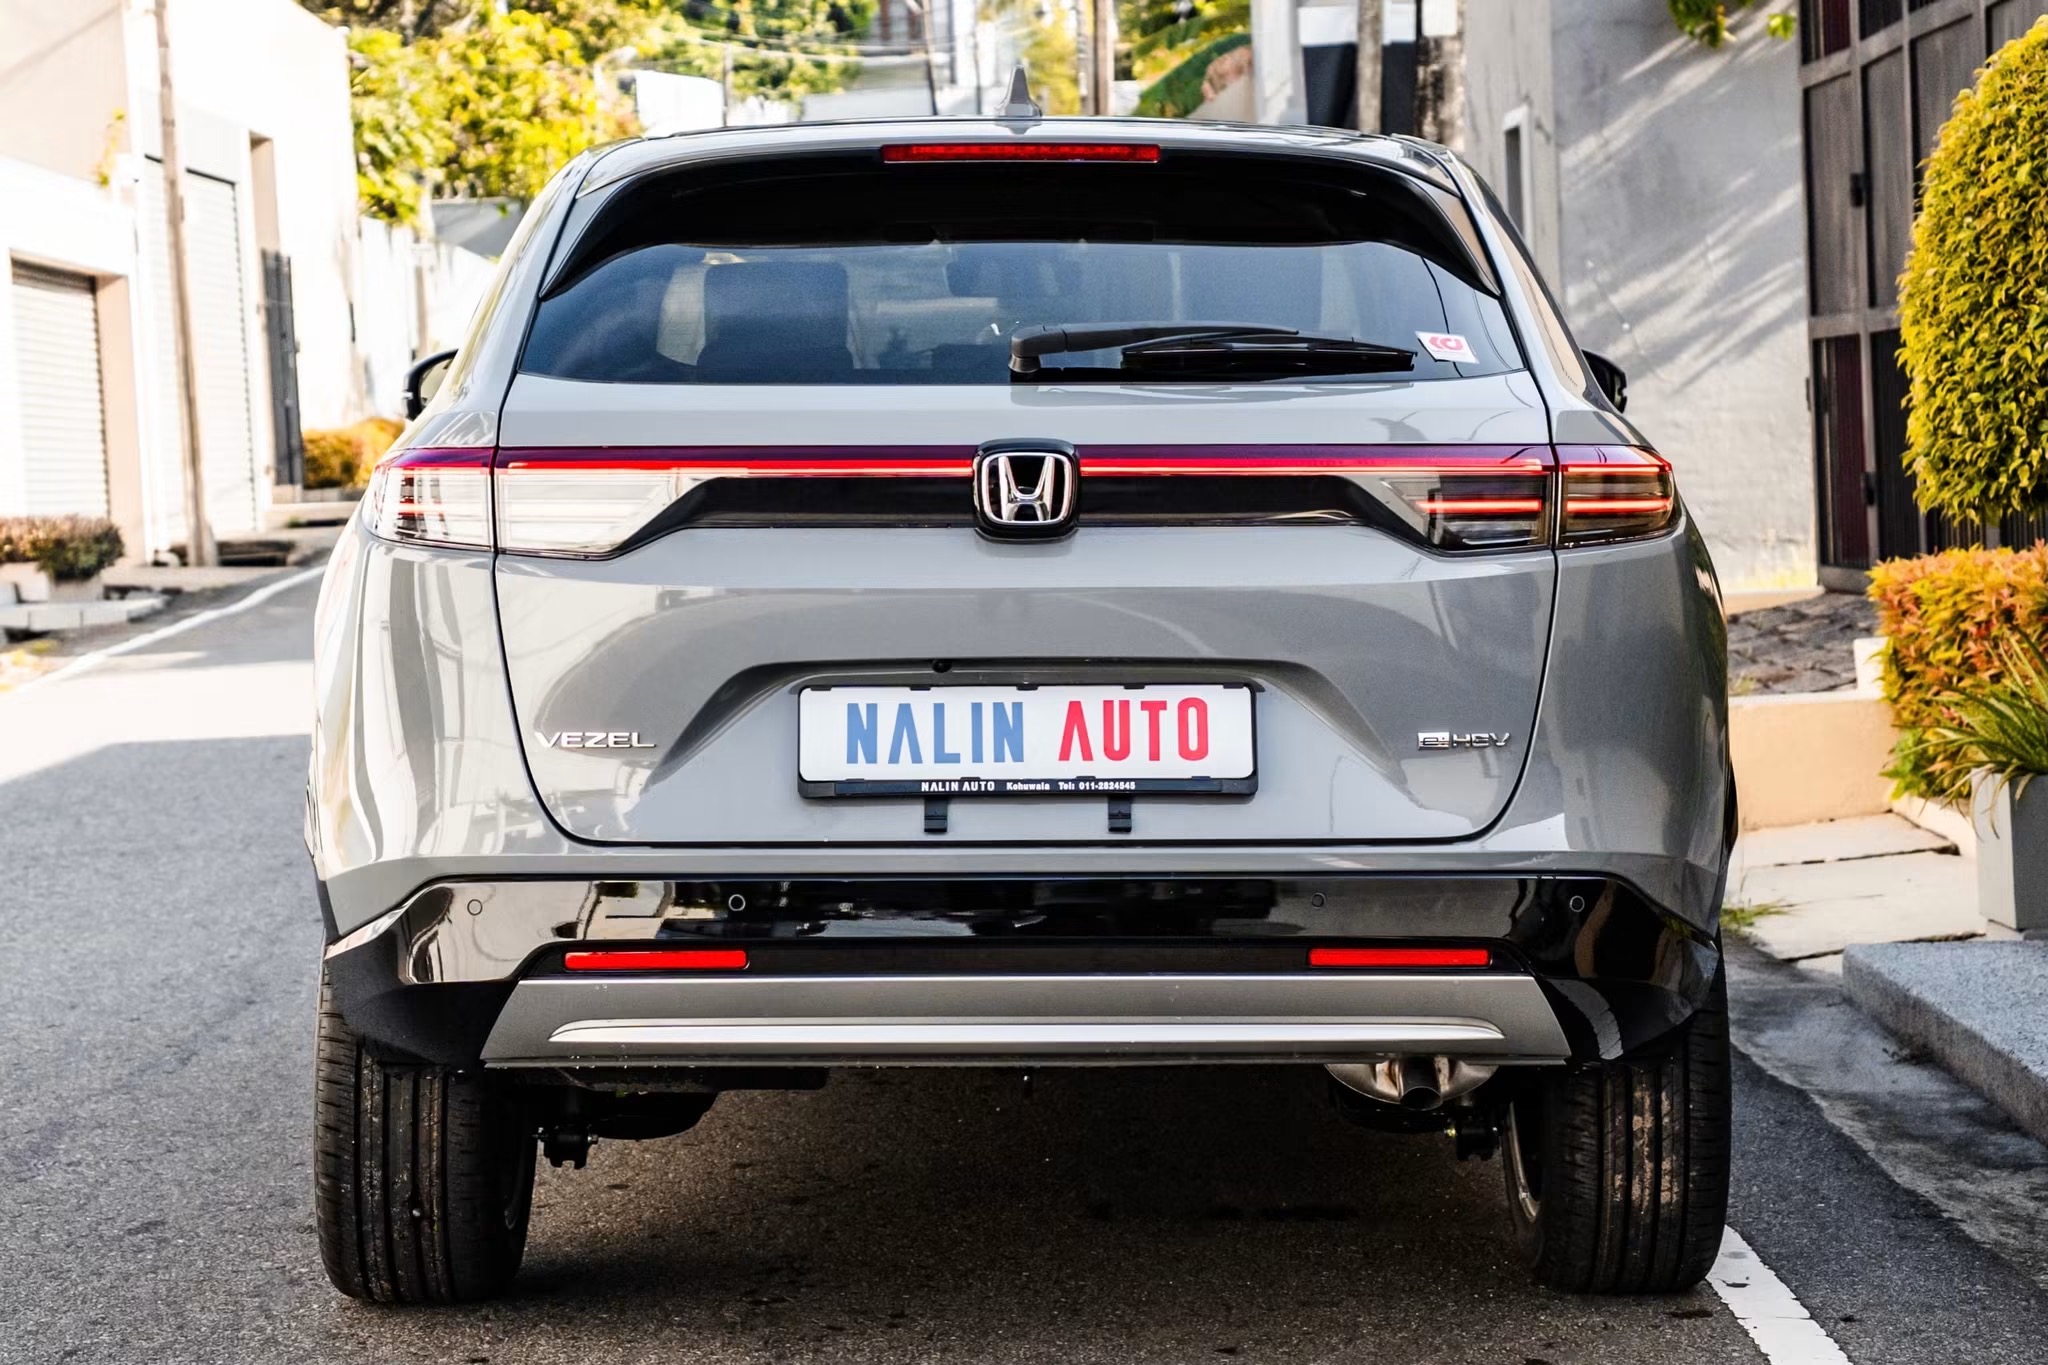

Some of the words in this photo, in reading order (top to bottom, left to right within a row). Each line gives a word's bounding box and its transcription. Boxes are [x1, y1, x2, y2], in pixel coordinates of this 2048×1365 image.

[846, 702, 1024, 764] NALIN
[1058, 697, 1209, 762] AUTO
[534, 732, 656, 749] VEZEL
[921, 781, 959, 792] NALIN
[962, 781, 995, 791] AUTO
